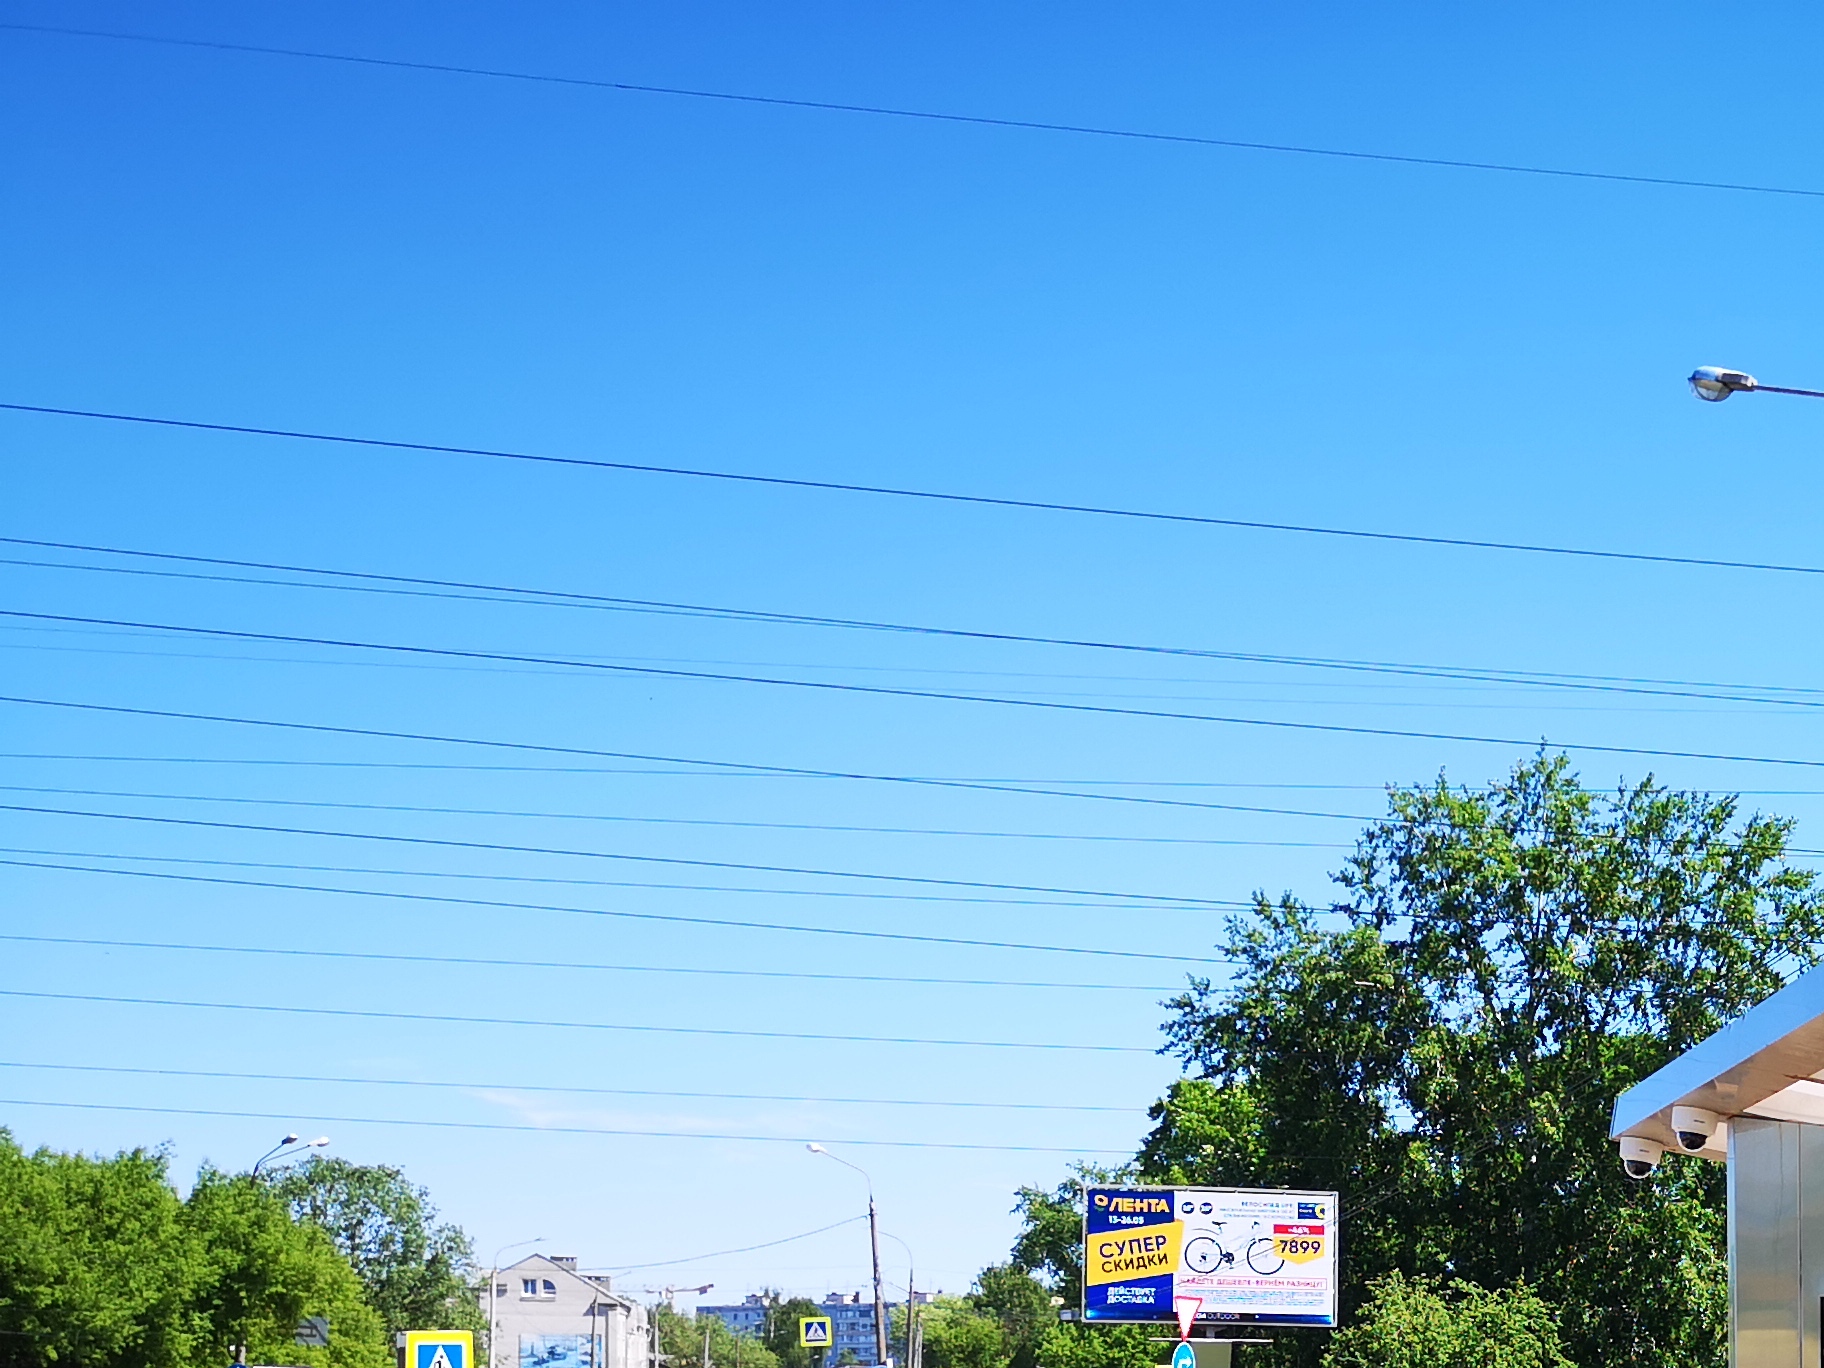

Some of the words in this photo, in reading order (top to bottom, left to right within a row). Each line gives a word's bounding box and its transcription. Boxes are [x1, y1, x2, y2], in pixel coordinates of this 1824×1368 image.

[1108, 1197, 1170, 1214] ЛЕНТА
[1099, 1234, 1168, 1260] СУПЕР
[1279, 1239, 1321, 1254] 7899
[1101, 1252, 1169, 1274] СКИДКИ
[1106, 1286, 1156, 1298] ДЕЙСТВУЕТ
[1106, 1295, 1155, 1305] ДОСТАВКА
